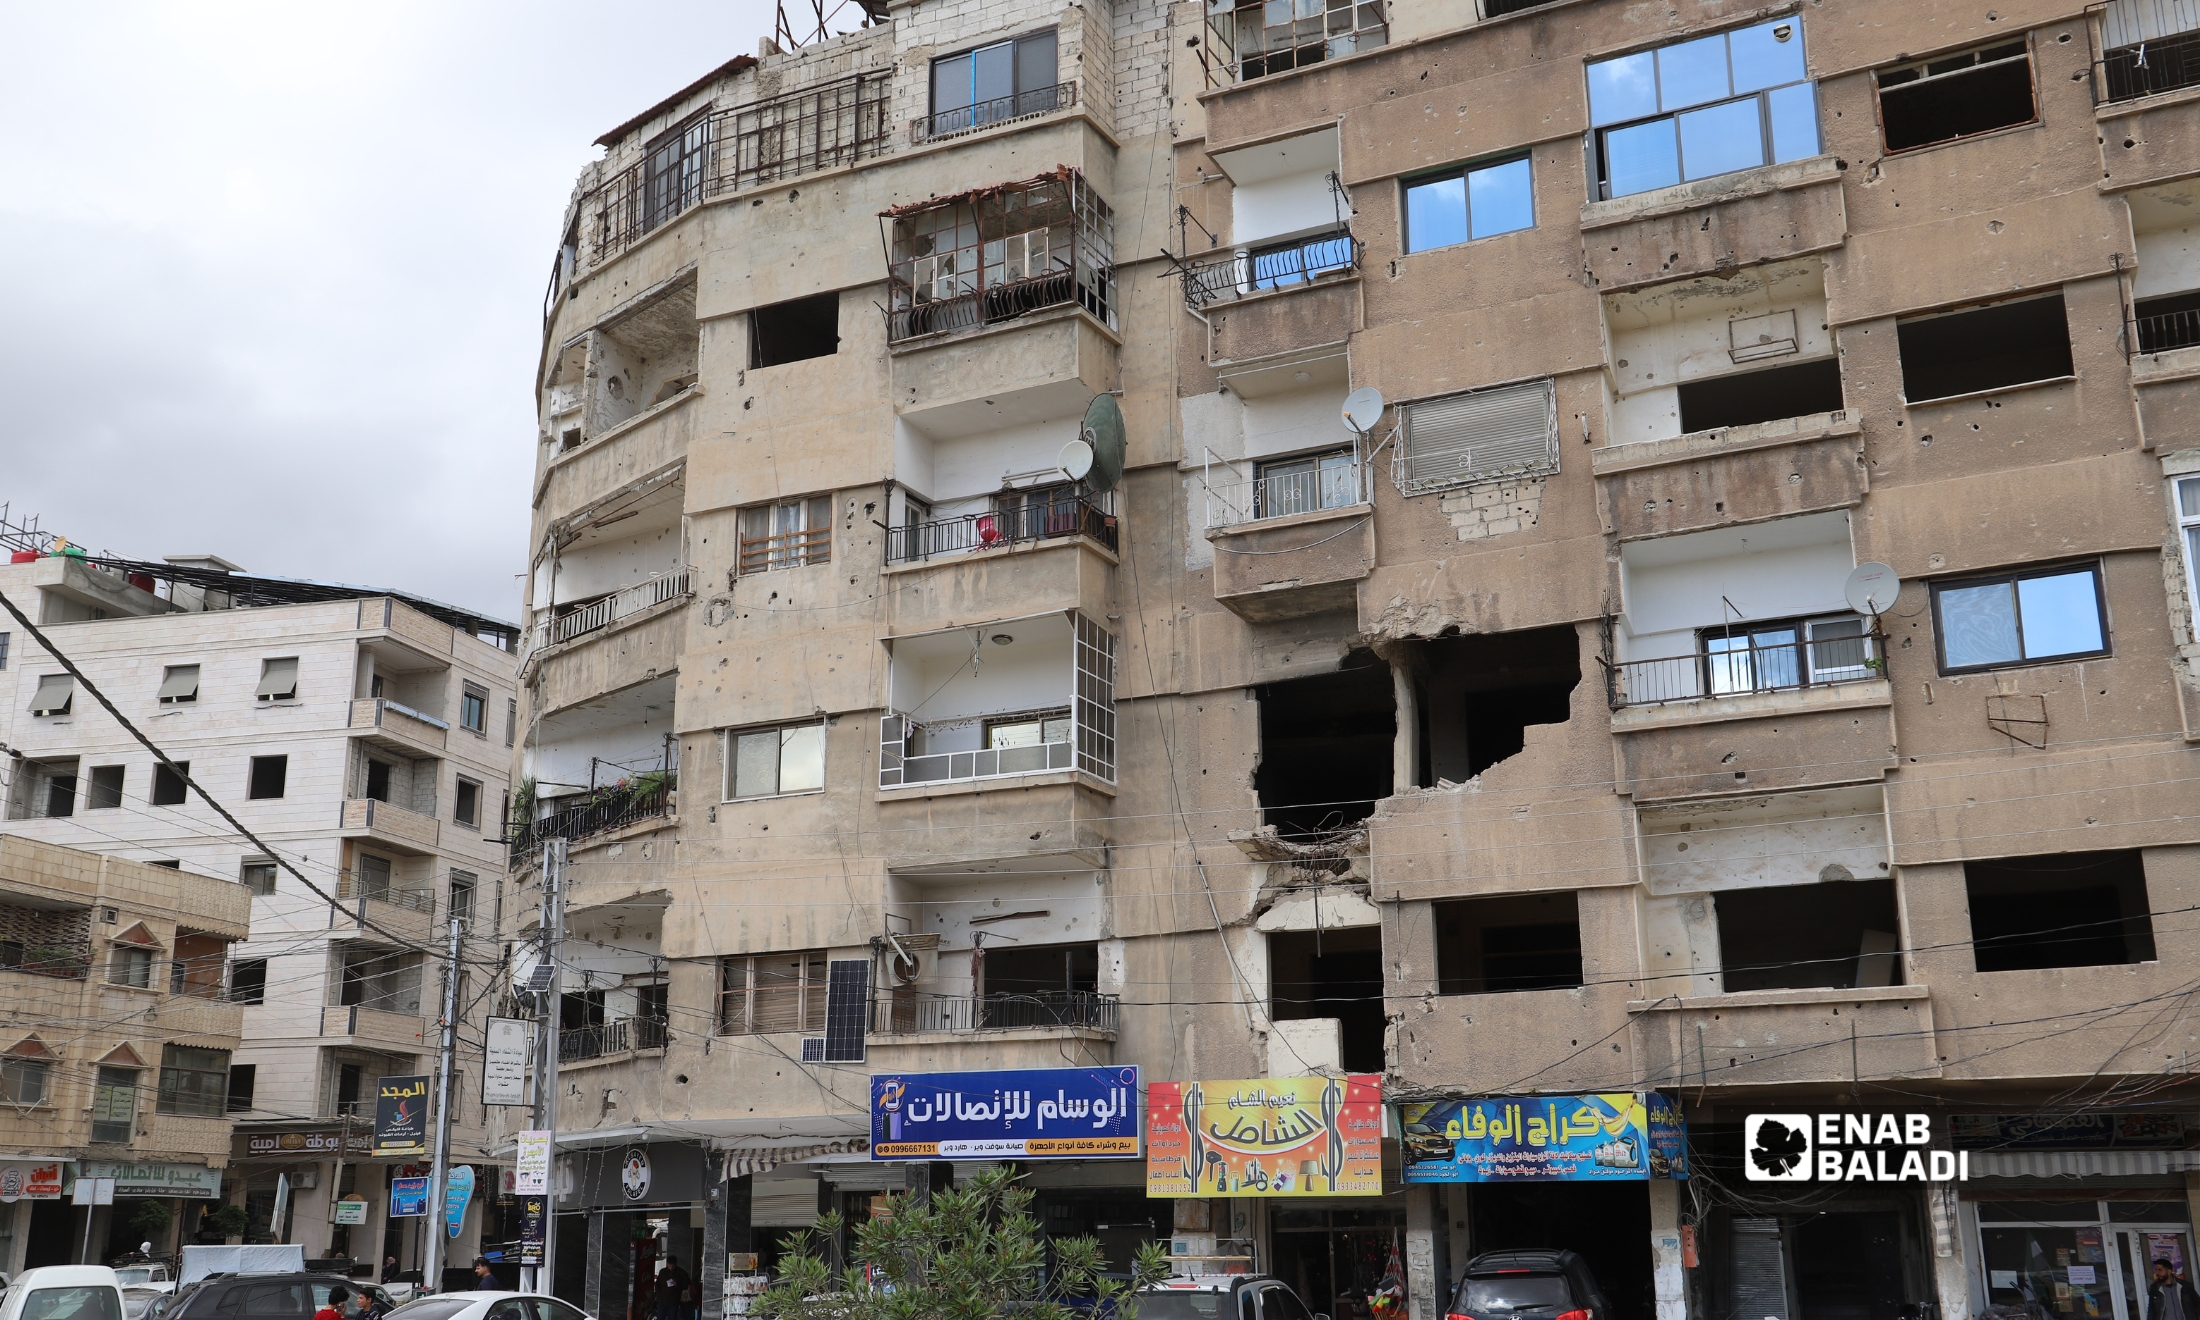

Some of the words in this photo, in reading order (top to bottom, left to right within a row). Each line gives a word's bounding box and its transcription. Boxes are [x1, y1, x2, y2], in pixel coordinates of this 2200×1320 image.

[380, 1082, 425, 1100] المجد
[1228, 1089, 1266, 1110] الشام
[1268, 1092, 1296, 1109] نعيم
[907, 1089, 1031, 1129] للإتصالات
[1037, 1087, 1127, 1130] الوسام
[1210, 1108, 1324, 1145] الشامل
[1445, 1103, 1523, 1146] الوفاء
[1528, 1103, 1601, 1146] كراج
[520, 1134, 548, 1146] بصريات
[1029, 1141, 1055, 1151] الأجهزة
[1076, 1141, 1095, 1149] كافة
[1096, 1140, 1117, 1150] وشراء
[1118, 1141, 1131, 1150] بيع
[890, 1145, 935, 1153] 0996667131
[943, 1144, 953, 1152] وير
[973, 1143, 984, 1152] وير
[985, 1143, 1004, 1151] سوفت
[1057, 1141, 1075, 1152] أنواع
[168, 1168, 202, 1187] عبدو
[1353, 1166, 1374, 1179] هدايا
